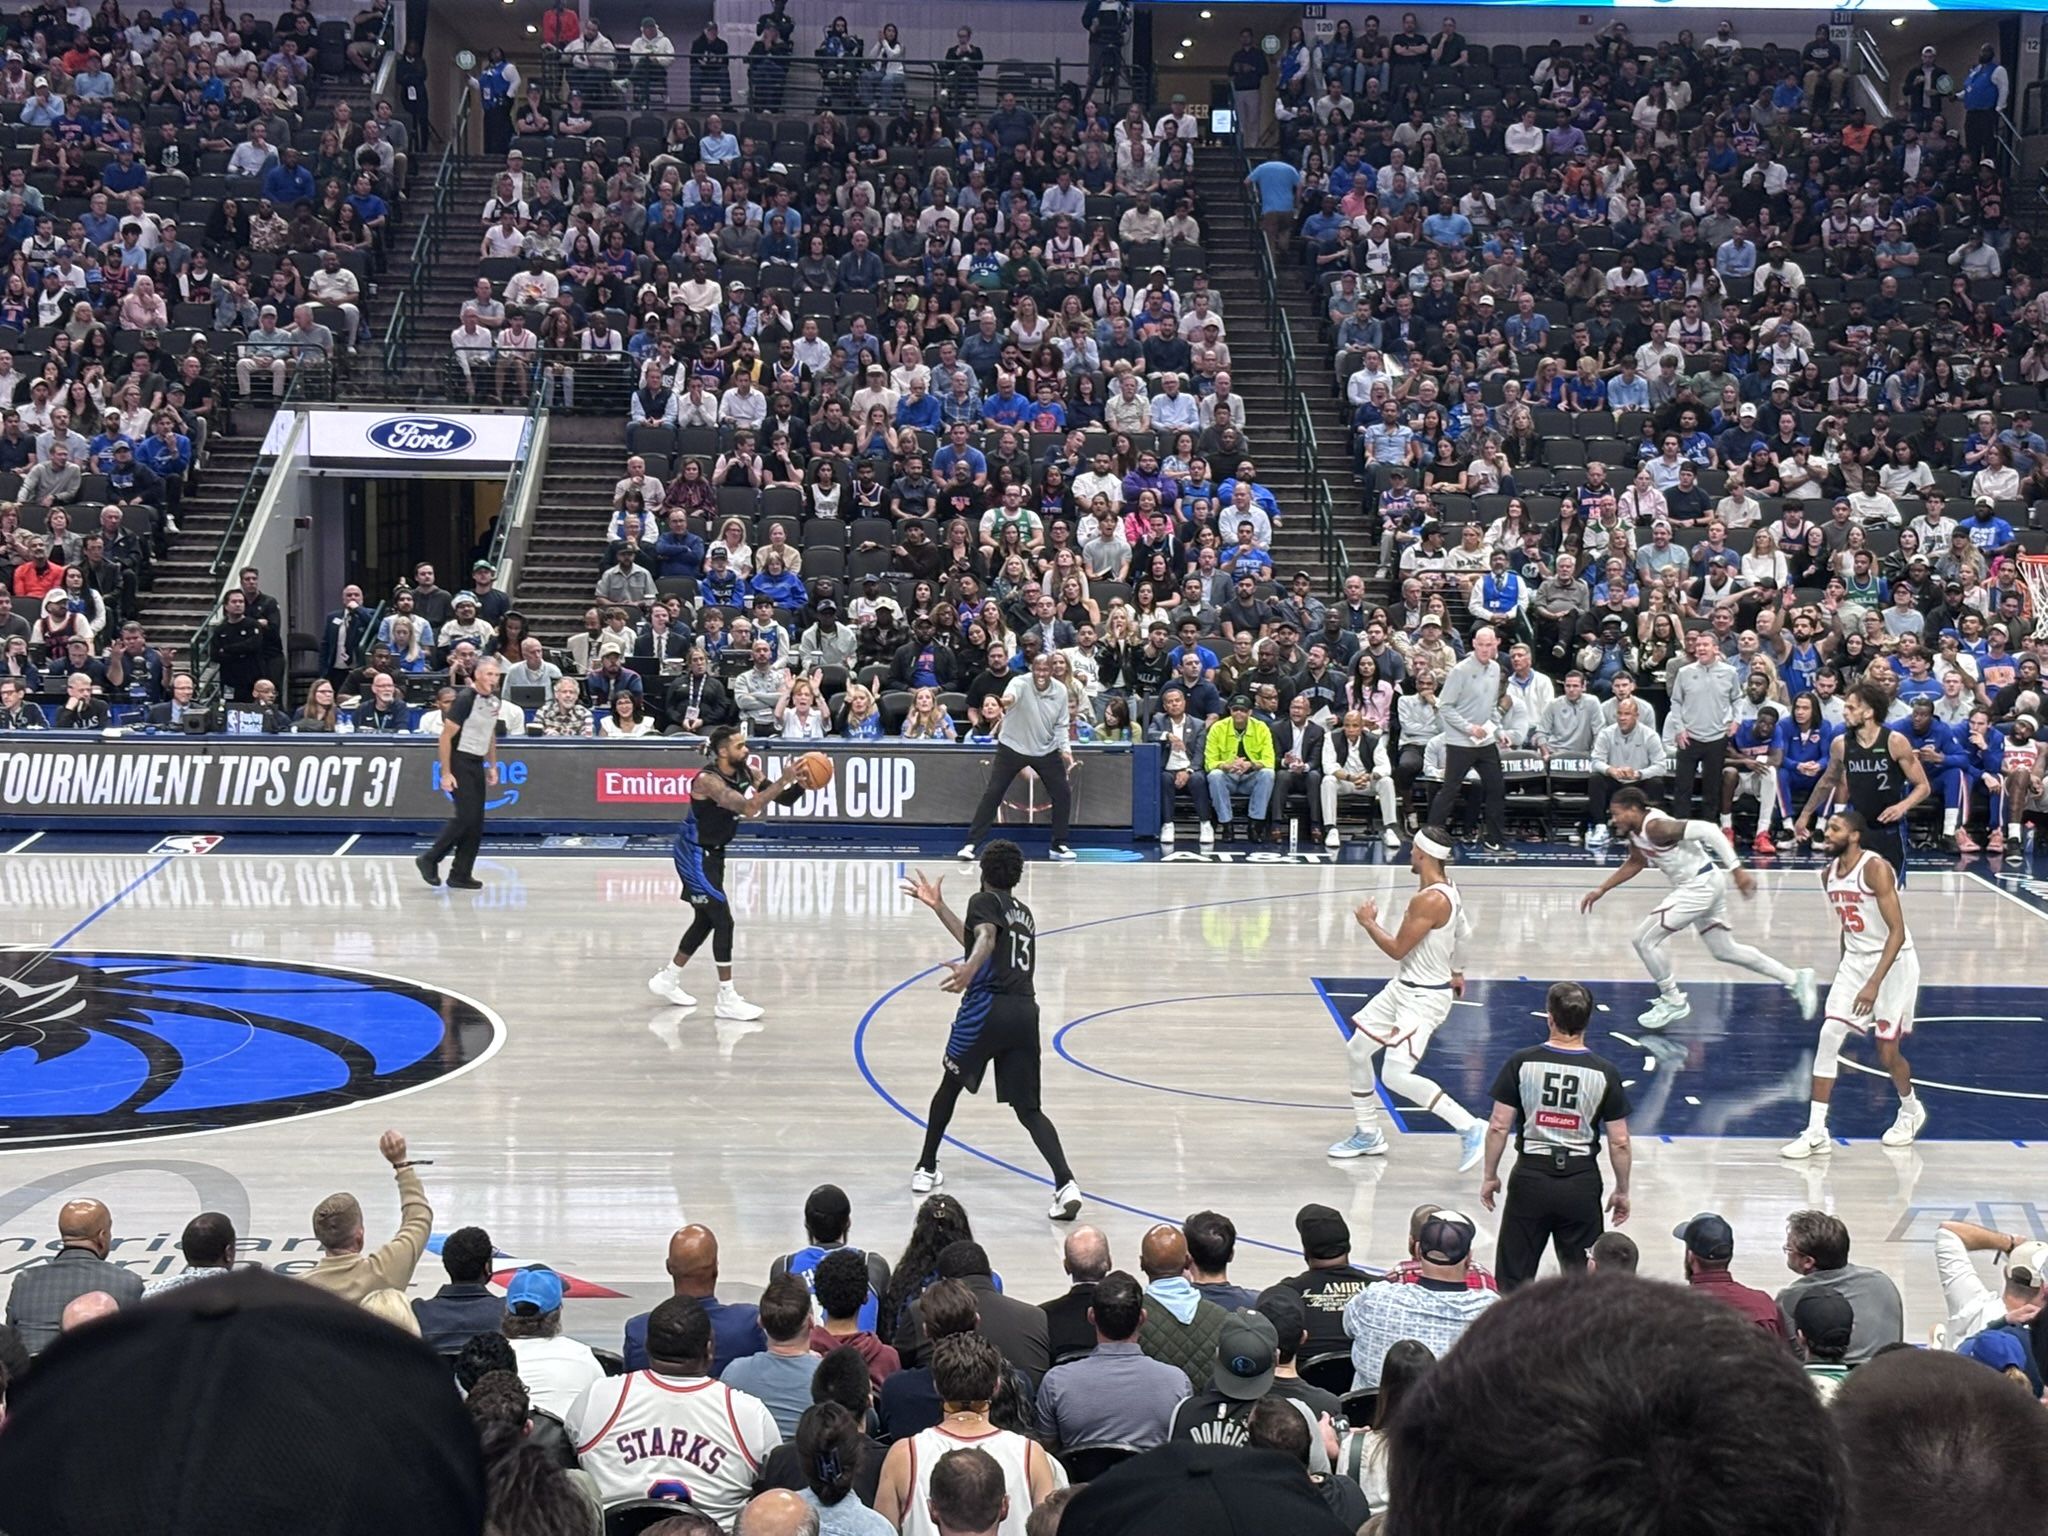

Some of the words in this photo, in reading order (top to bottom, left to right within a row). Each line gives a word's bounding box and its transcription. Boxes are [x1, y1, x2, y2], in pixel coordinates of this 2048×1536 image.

[1306, 5, 1324, 17] EXIT
[1316, 22, 1333, 32] 120
[1830, 29, 1847, 38] 120
[2027, 40, 2040, 50] 12
[387, 421, 455, 449] Ford
[1848, 759, 1889, 772] DALLAS
[0, 752, 214, 805] TOURNAMENT
[216, 755, 290, 807] TIPS
[293, 755, 362, 807] OCT
[362, 756, 402, 807] 31
[1876, 773, 1891, 790] 2
[845, 757, 915, 818] CUP
[1160, 851, 1333, 863] AT&T
[1009, 930, 1031, 972] 13
[1541, 1072, 1580, 1110] 52
[1540, 1113, 1577, 1126] Emirates
[616, 1427, 727, 1475] STARKS
